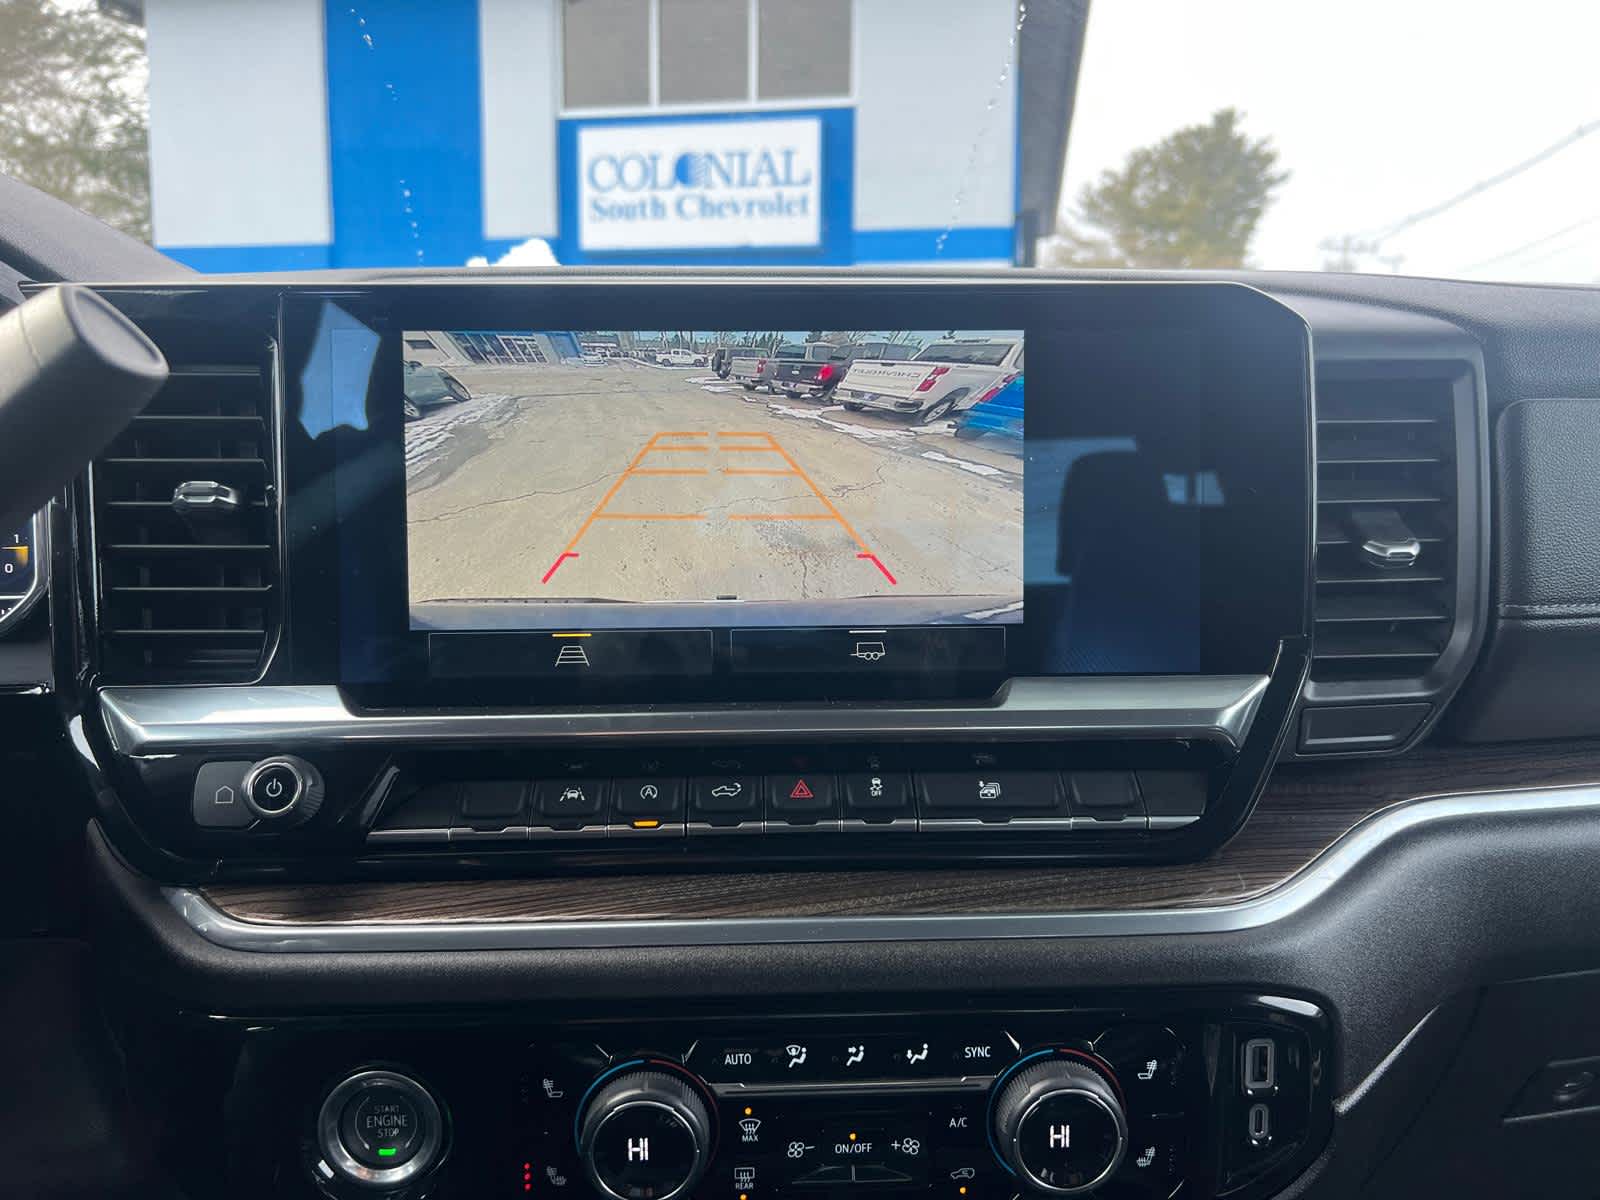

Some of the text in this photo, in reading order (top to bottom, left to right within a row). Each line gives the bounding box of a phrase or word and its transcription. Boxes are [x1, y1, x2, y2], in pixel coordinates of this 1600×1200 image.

[588, 148, 812, 193] COLONIAL
[591, 190, 809, 219] South Chevrolet
[964, 1046, 991, 1058] SYNC
[724, 1053, 752, 1066] AUTO
[374, 1105, 400, 1113] START
[366, 1115, 408, 1129] ENGINE
[949, 1116, 968, 1129] A/C
[377, 1129, 400, 1137] STOP
[741, 1134, 759, 1142] MAX
[1049, 1124, 1070, 1148] HI
[627, 1137, 649, 1161] HI
[834, 1143, 873, 1155] ON/OFF
[735, 1182, 754, 1190] REAR
